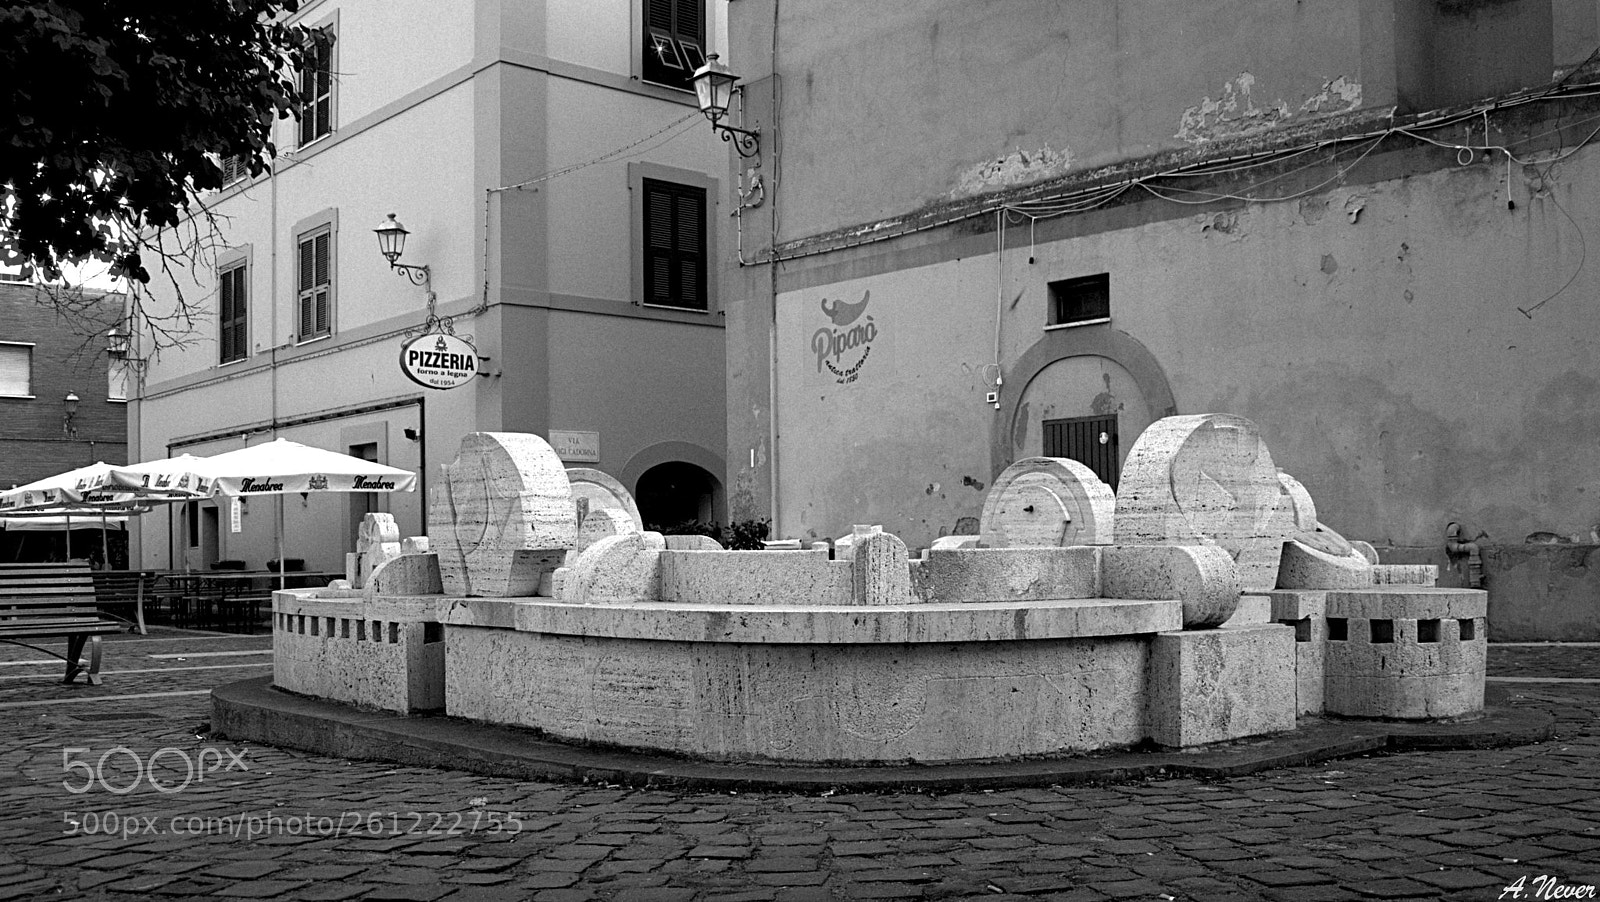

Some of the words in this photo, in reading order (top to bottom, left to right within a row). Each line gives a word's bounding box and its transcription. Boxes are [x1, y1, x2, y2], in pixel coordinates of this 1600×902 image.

[811, 315, 878, 374] Piparò
[409, 350, 475, 371] PIZZERIA
[417, 367, 439, 375] forno
[447, 369, 468, 378] legna
[240, 477, 284, 493] Menabrea
[352, 475, 395, 490] Menabrea
